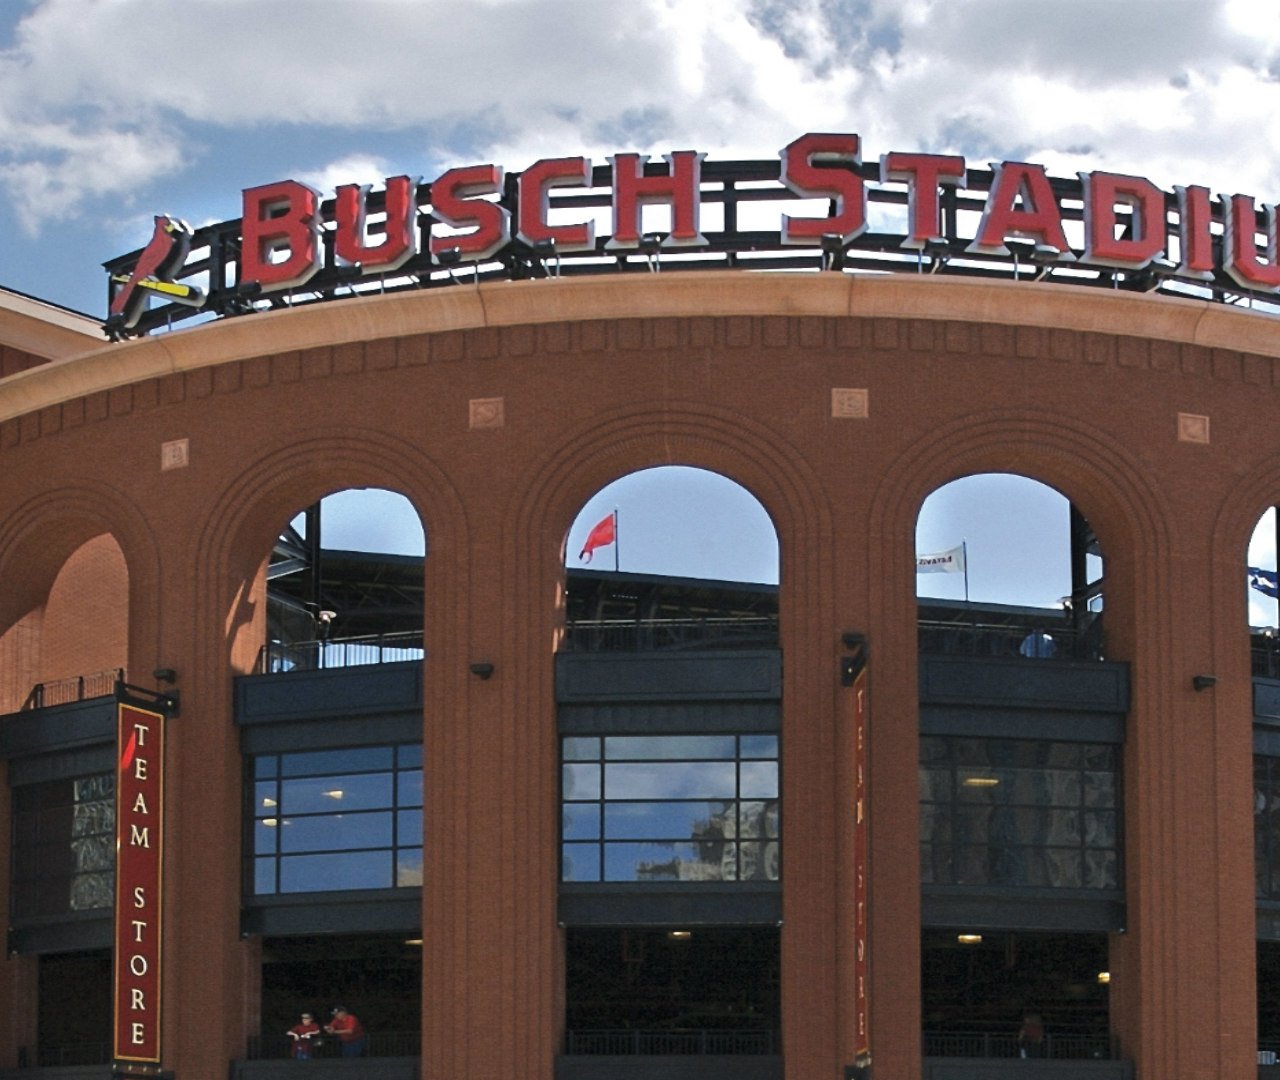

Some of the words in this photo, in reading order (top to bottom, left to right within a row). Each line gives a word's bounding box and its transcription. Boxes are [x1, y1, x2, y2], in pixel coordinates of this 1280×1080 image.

[240, 149, 709, 293] BUSCH
[130, 723, 151, 850] TEAM
[130, 886, 149, 1046] STORE
